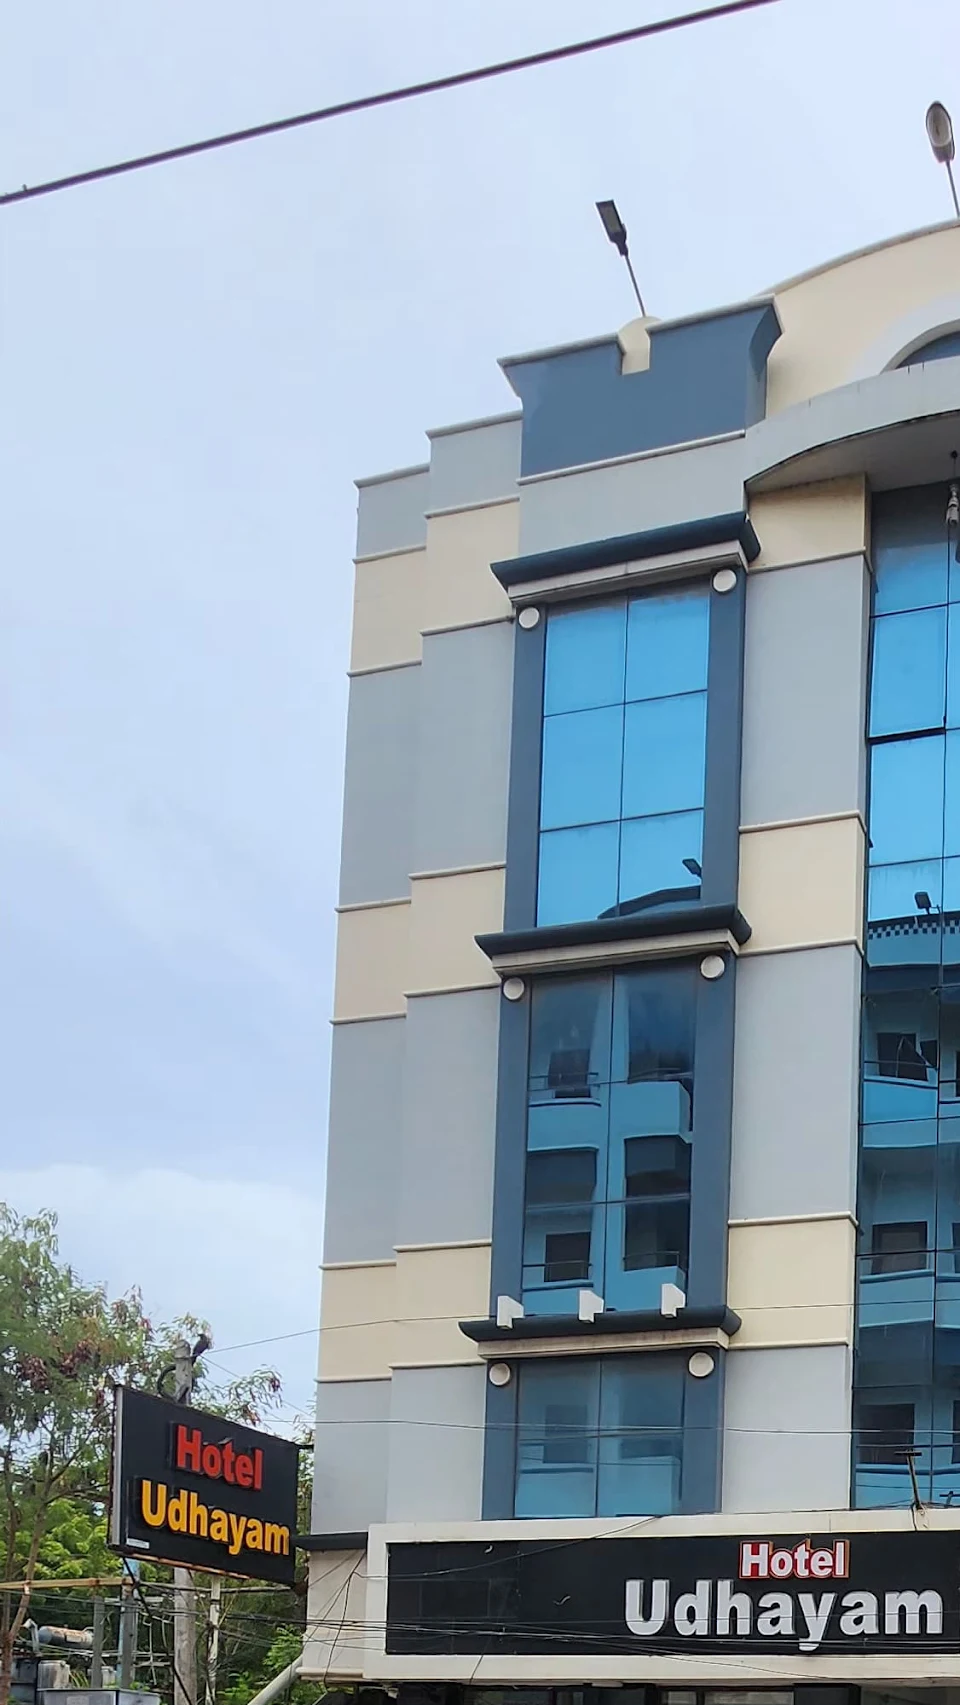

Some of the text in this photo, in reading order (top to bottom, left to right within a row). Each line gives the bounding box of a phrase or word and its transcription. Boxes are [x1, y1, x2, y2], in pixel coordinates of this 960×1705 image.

[177, 1424, 264, 1490] Hotel
[142, 1479, 290, 1555] Udhayam
[740, 1540, 849, 1578] Hotel
[625, 1578, 944, 1651] Udhayam
